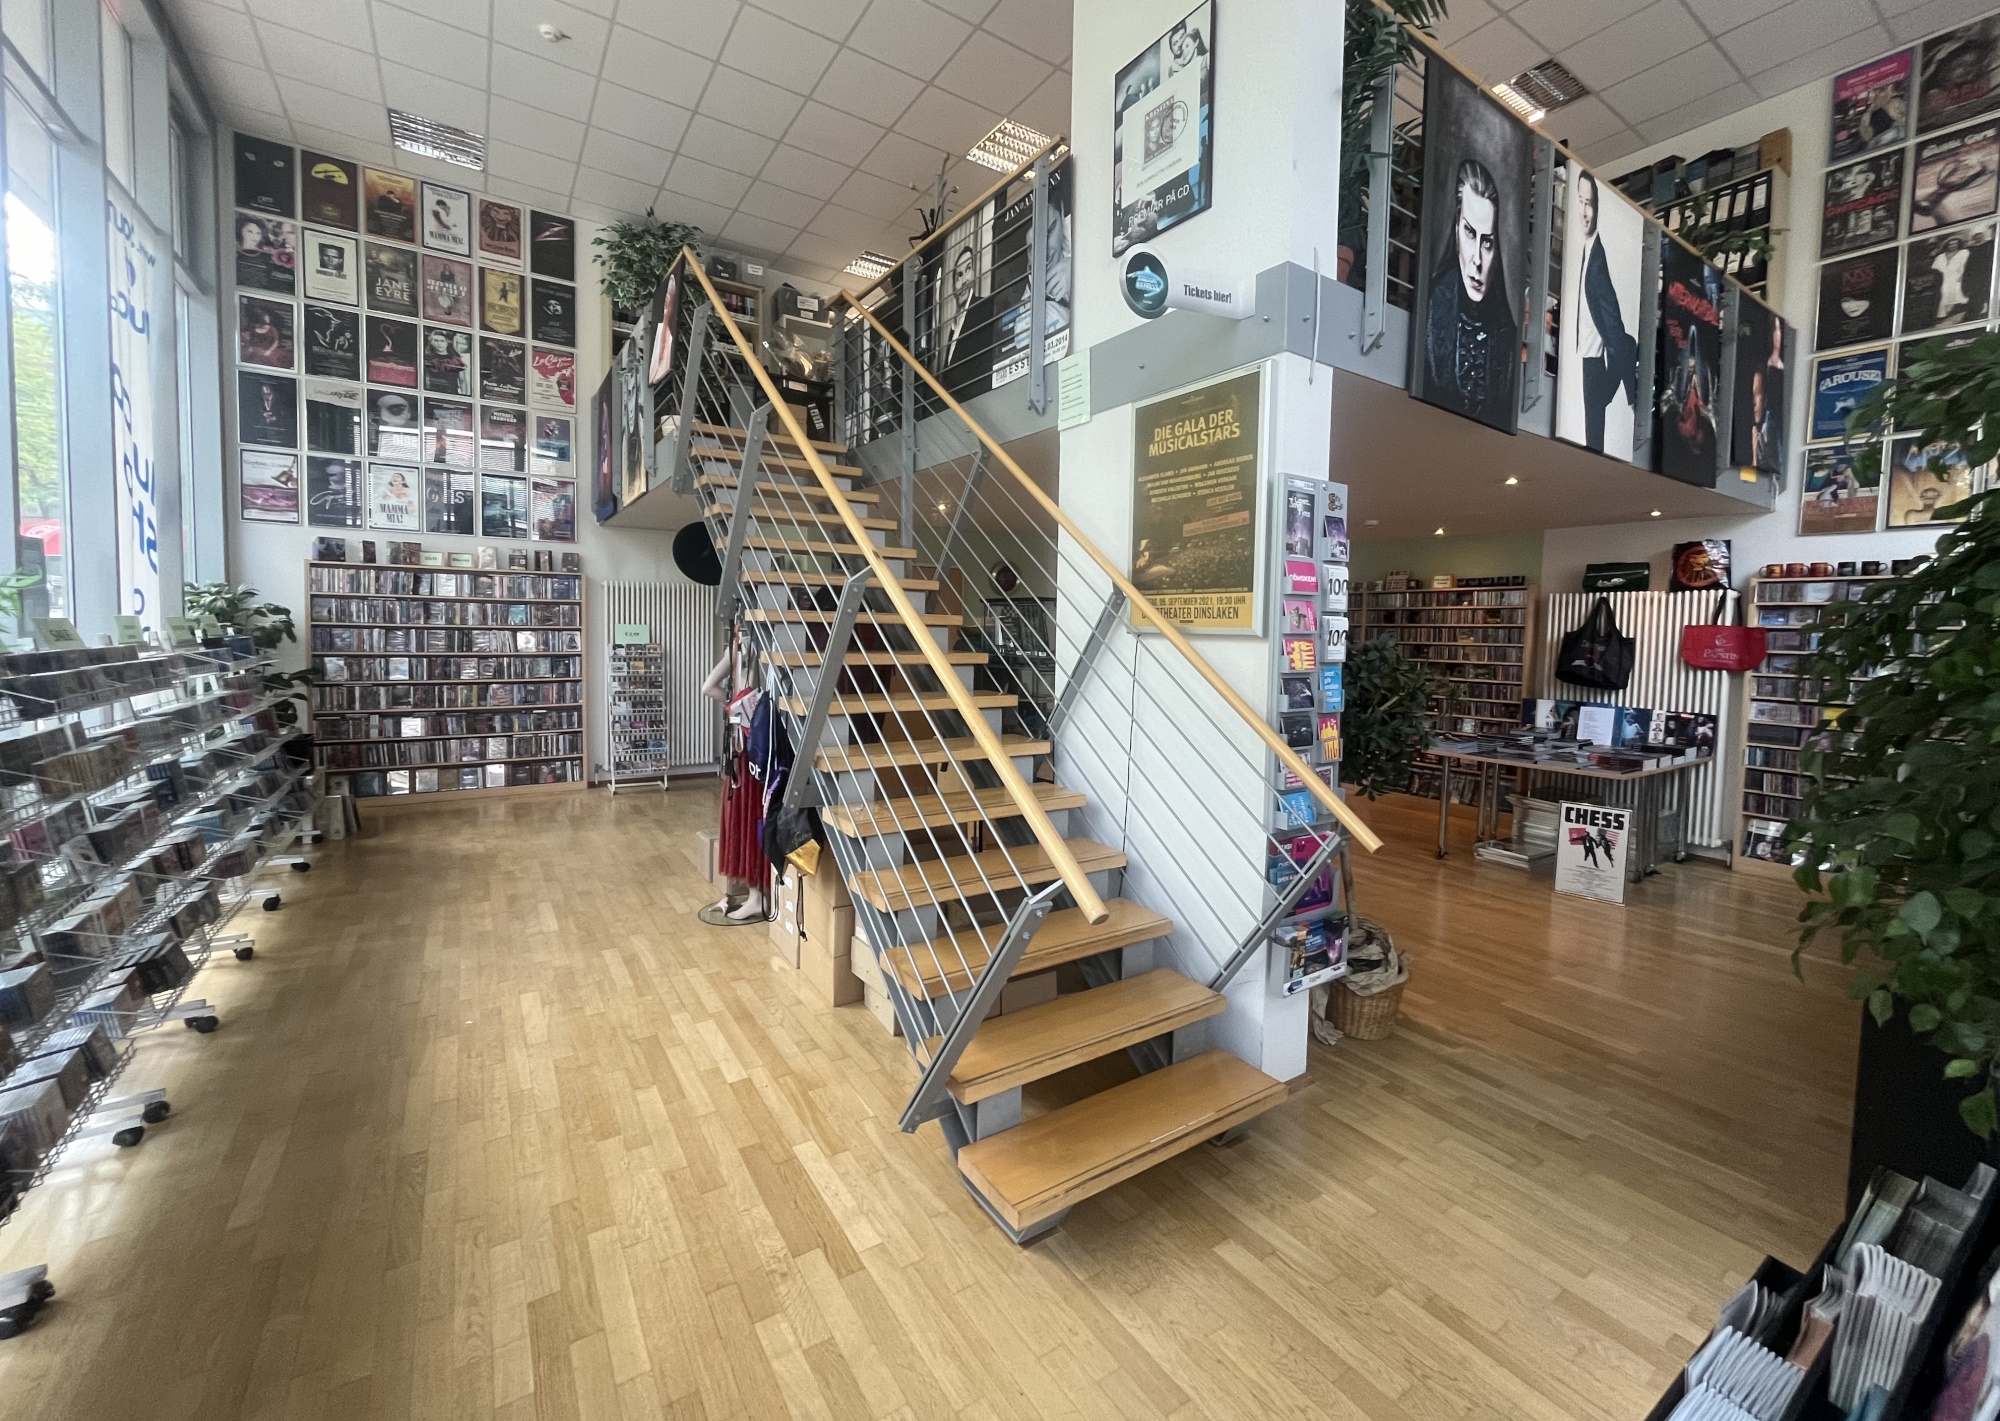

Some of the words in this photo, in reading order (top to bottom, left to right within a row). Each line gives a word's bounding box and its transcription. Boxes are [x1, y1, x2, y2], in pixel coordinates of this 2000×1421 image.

[1166, 188, 1176, 206] PÅ
[1177, 184, 1190, 199] CD
[376, 278, 410, 292] JANE
[376, 286, 410, 301] EYRE
[1184, 284, 1212, 300] Tickets
[1213, 290, 1232, 304] hier!
[1154, 424, 1172, 442] DIE
[1174, 416, 1206, 436] GALA
[1209, 408, 1234, 428] DER
[1148, 422, 1240, 457] MUSICALSTARS
[380, 503, 409, 515] MAMMA
[386, 513, 403, 524] MIA!
[1329, 578, 1348, 596] 100
[1168, 597, 1198, 606] SEPTEMBER
[1216, 596, 1233, 605] 19:30
[1234, 596, 1246, 605] UHR
[1194, 606, 1239, 619] DINSLAKEN
[1328, 629, 1347, 646] 100
[1564, 806, 1625, 830] CHESS
